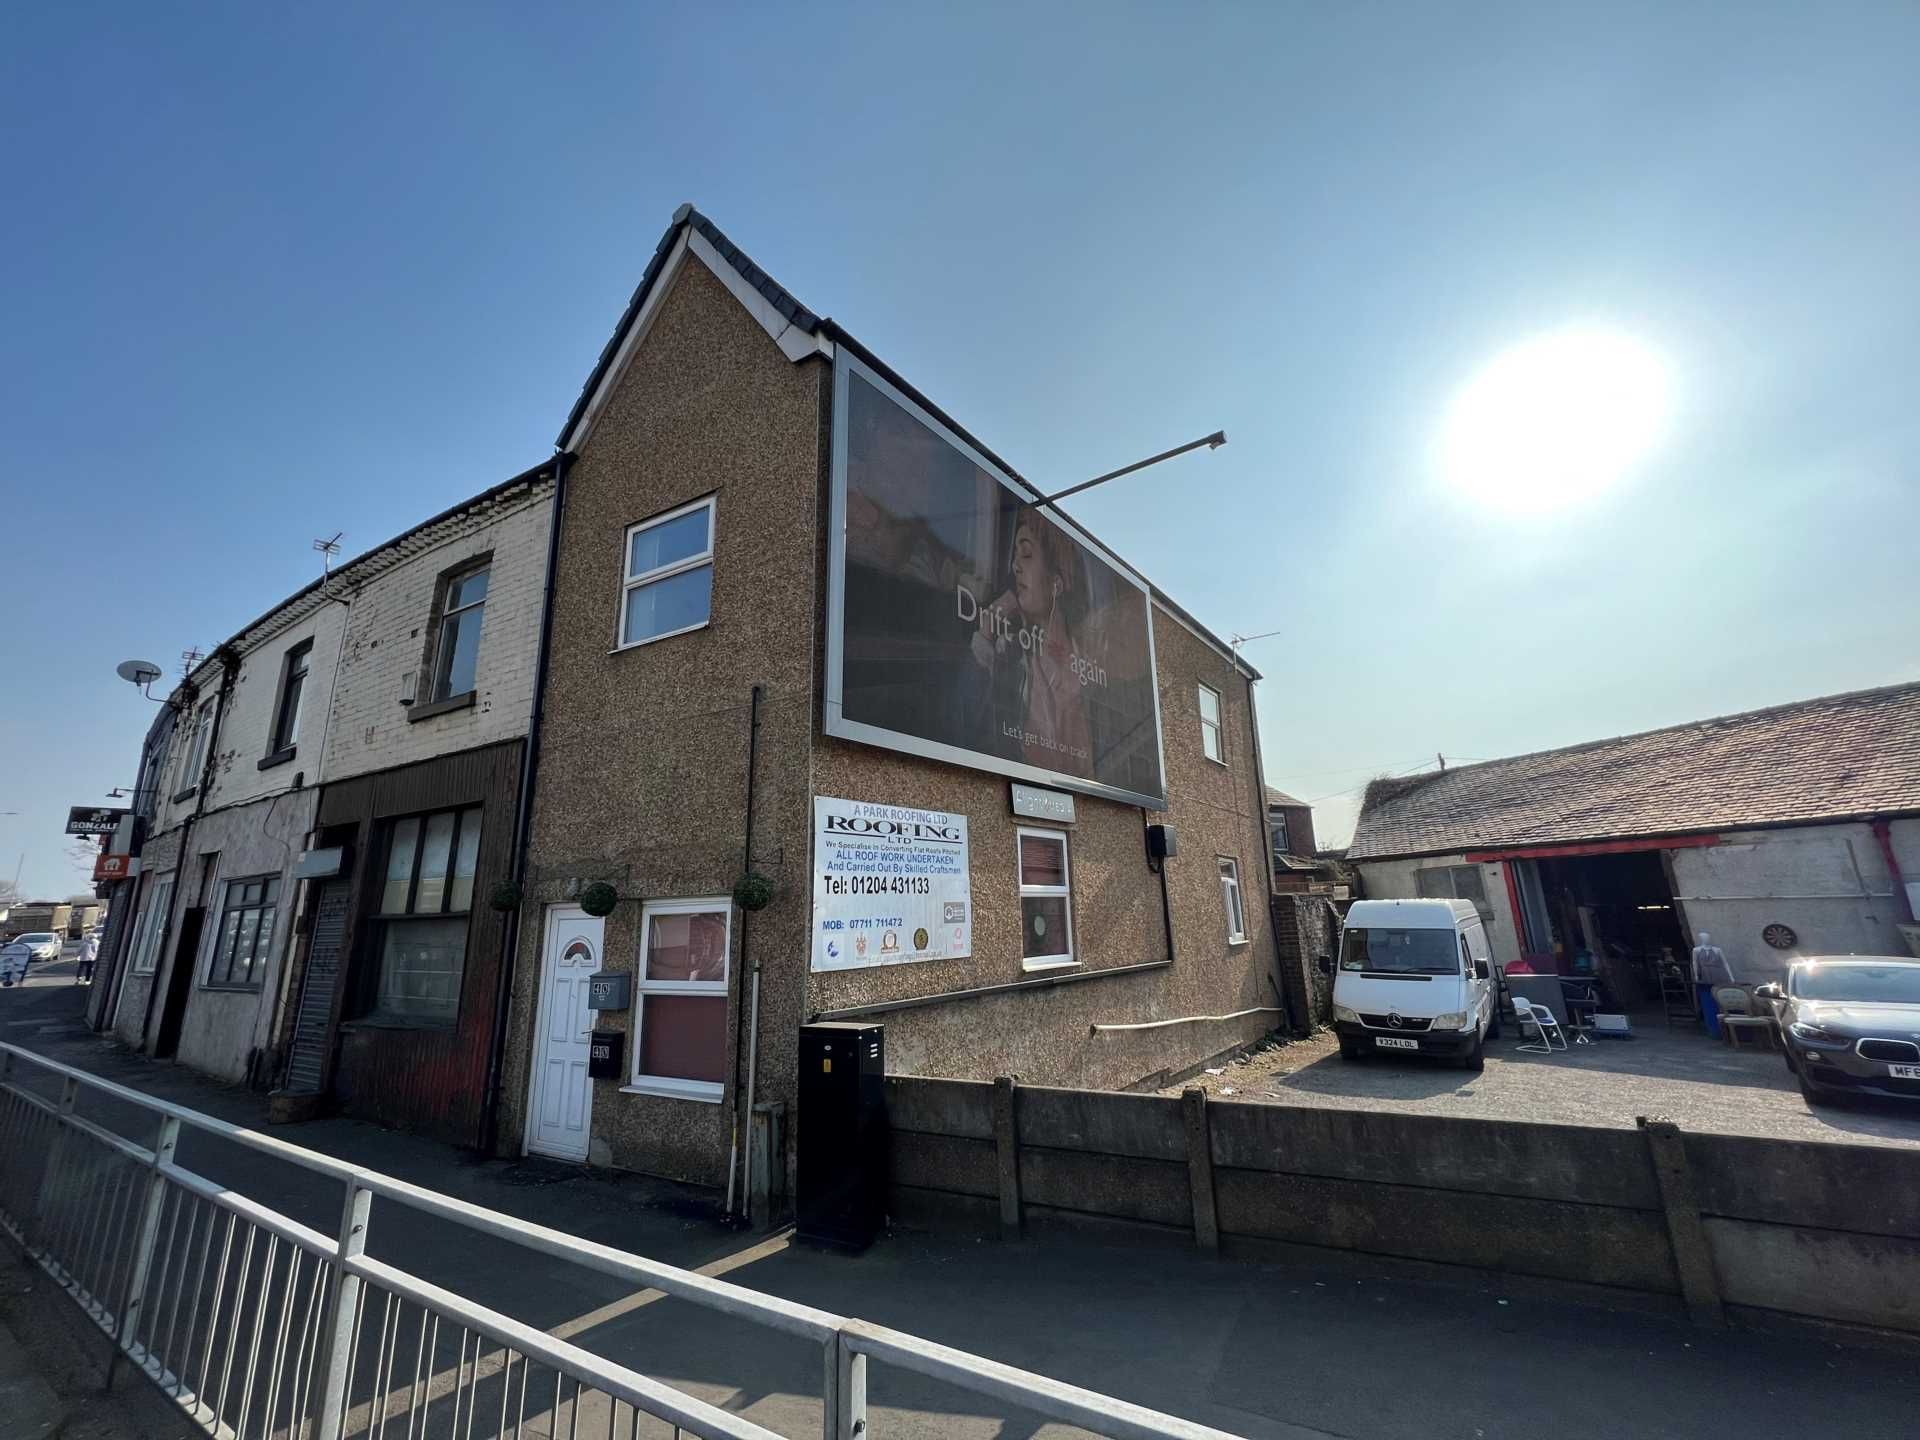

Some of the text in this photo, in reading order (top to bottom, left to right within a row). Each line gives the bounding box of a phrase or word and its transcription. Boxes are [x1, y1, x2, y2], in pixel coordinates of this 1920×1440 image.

[957, 584, 1108, 688] Drift off again
[854, 804, 948, 825] A PARK ROOFING LTD
[825, 815, 960, 840] ROOFING
[825, 840, 837, 848] We
[880, 844, 913, 854] Converting
[914, 846, 925, 854] Flat
[888, 836, 912, 844] LTD
[836, 850, 954, 865] ALL ROOF WORK UNDERTAKEN
[827, 860, 844, 871] And
[846, 861, 876, 872] Carried
[877, 862, 891, 873] Out
[893, 863, 903, 875] By
[904, 864, 928, 874] Skilled
[824, 875, 930, 895] Tel: 01204 431133
[822, 917, 903, 930] MOB: 07711 711472
[593, 983, 609, 994] 40
[592, 1046, 609, 1058] 40
